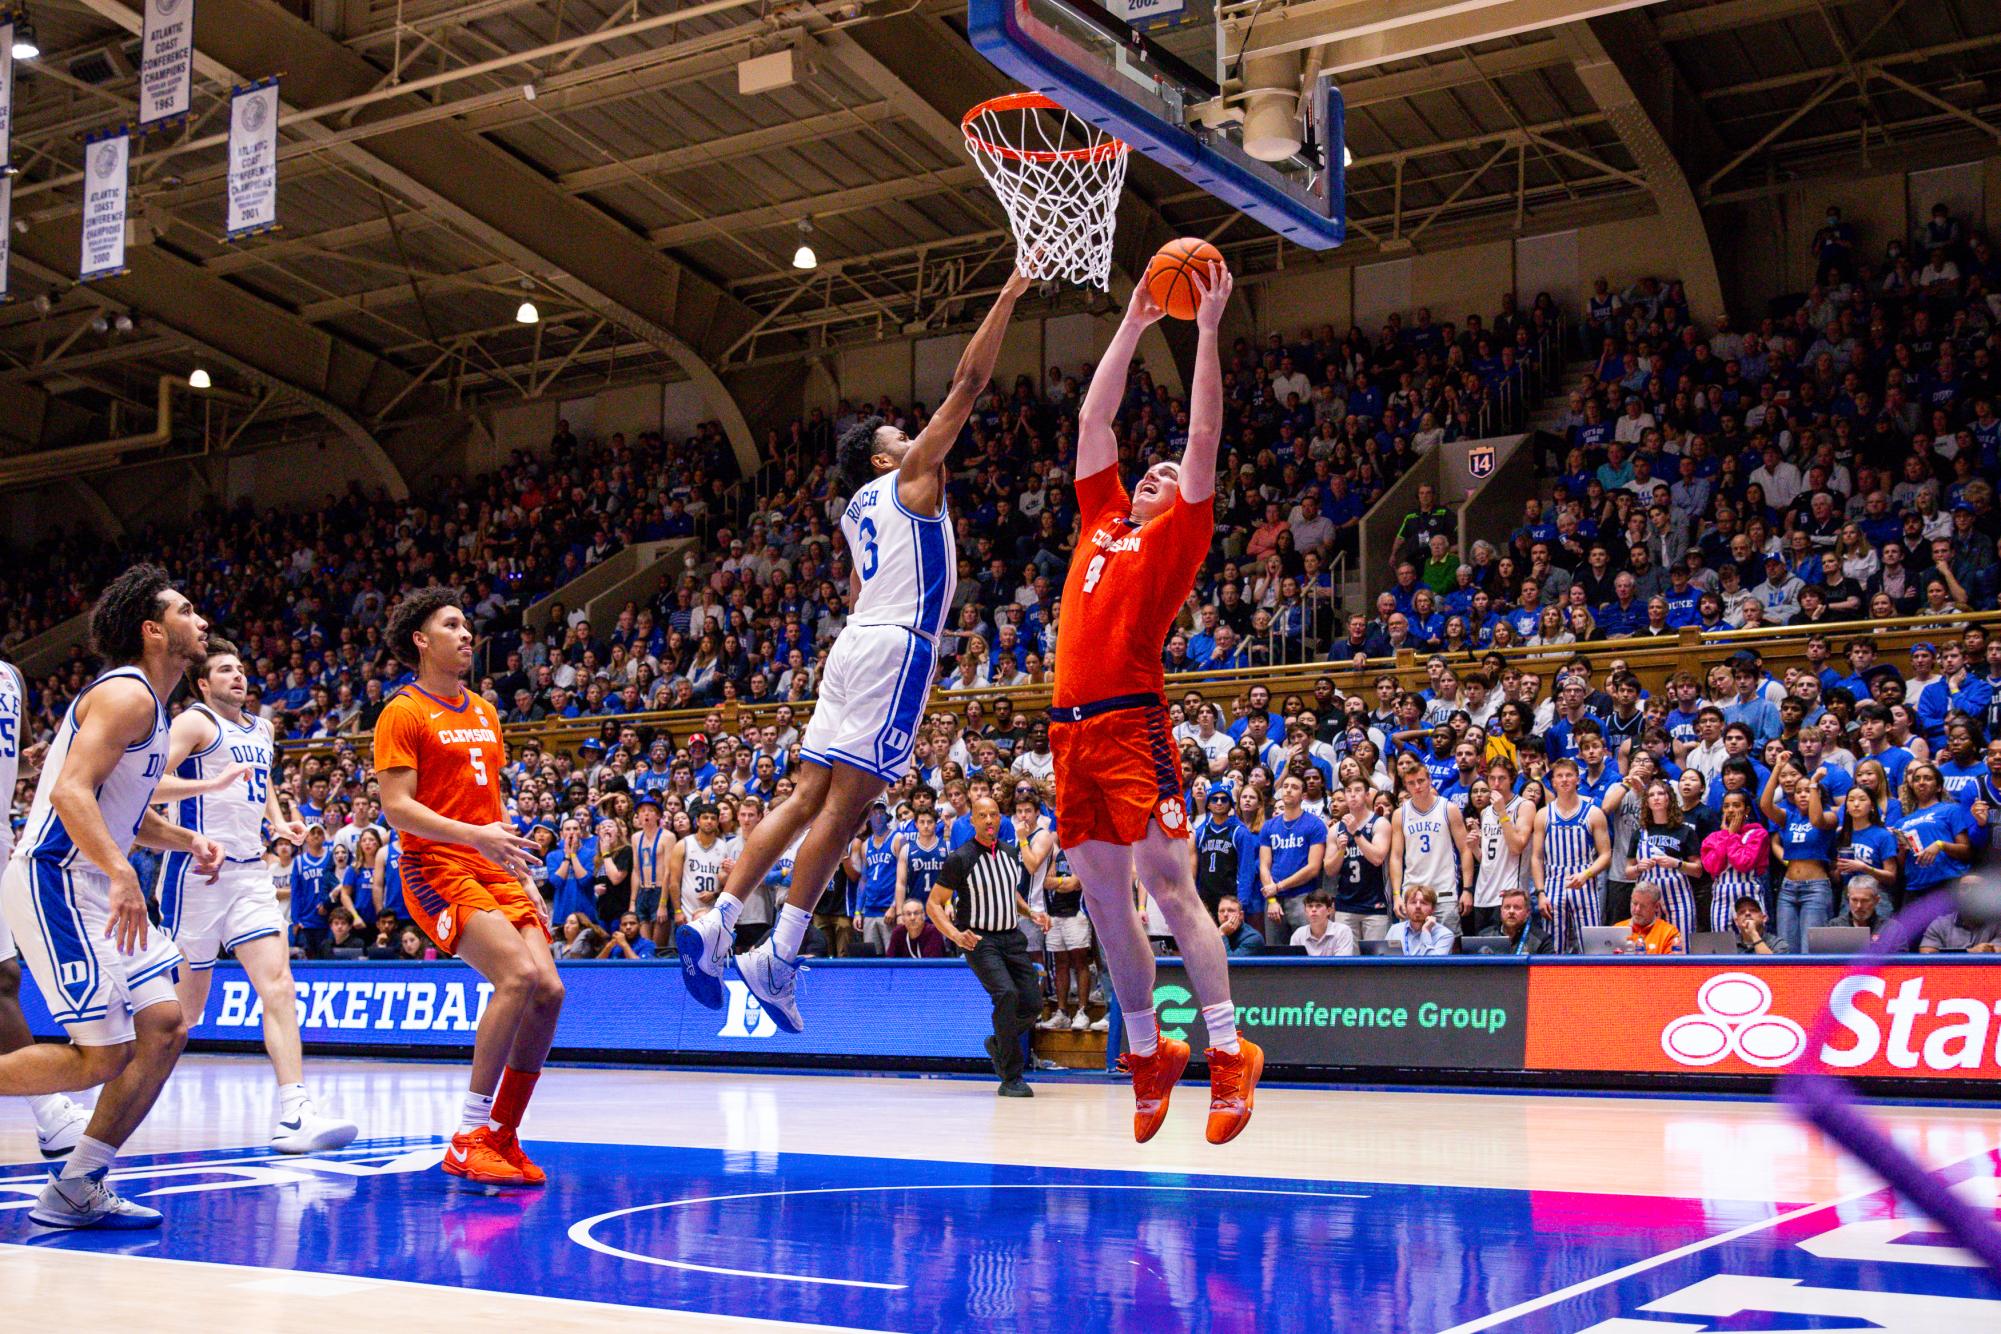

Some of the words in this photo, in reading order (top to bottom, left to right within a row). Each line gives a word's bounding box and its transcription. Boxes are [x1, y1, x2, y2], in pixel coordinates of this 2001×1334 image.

[151, 22, 183, 41] ATLANTIC
[155, 37, 178, 54] COAST
[143, 47, 189, 71] CONFERENCE
[144, 62, 186, 84] CHAMPIONS
[90, 187, 119, 202] ATLANTIC
[94, 201, 114, 214] COAST
[86, 211, 123, 228] CONFERENCE
[86, 223, 121, 240] CHAMPIONS
[1472, 454, 1491, 473] 14
[846, 490, 879, 524] ROCH
[859, 516, 879, 582] 3
[1082, 554, 1106, 594] 4
[1072, 706, 1082, 721] C
[0, 717, 15, 758] 5
[438, 728, 498, 745] CLEMSON
[1670, 723, 1695, 738] DUK
[469, 748, 489, 786] 5
[247, 768, 268, 803] 15
[1407, 820, 1442, 835] DUKE
[1483, 823, 1503, 837] Duk
[1202, 839, 1232, 853] DUKE
[1270, 833, 1304, 850] Duke
[1419, 834, 1431, 853] 3
[1487, 839, 1498, 861] 5
[866, 853, 893, 866] DUKE
[1343, 845, 1364, 859] Duk
[1852, 843, 1874, 865] KE
[1209, 852, 1216, 873] 1
[872, 865, 879, 881] 1
[1349, 861, 1361, 884] 3
[313, 879, 319, 894] 1
[694, 876, 715, 893] 30
[924, 873, 931, 892] 1
[1418, 1001, 1507, 1034] Group
[1820, 973, 2001, 1071] Sta
